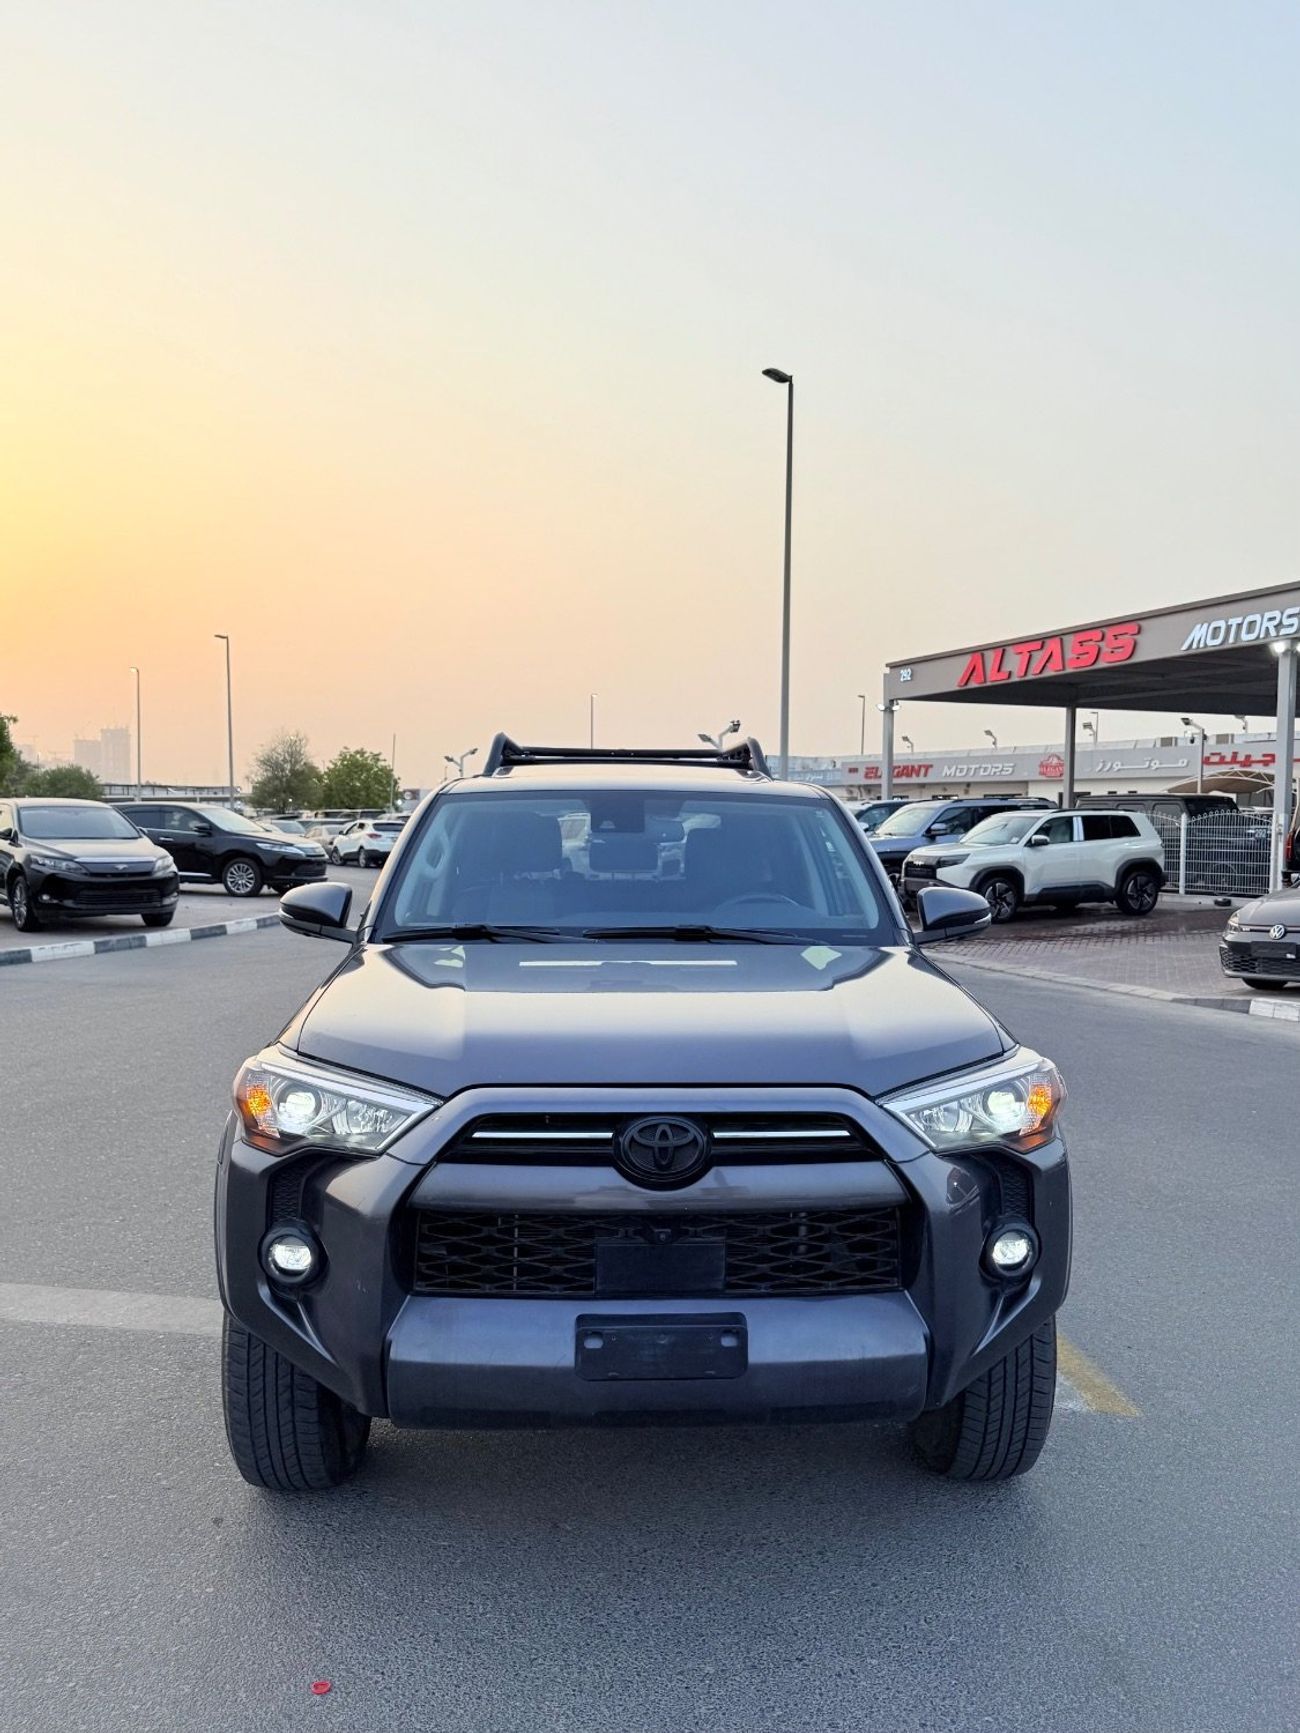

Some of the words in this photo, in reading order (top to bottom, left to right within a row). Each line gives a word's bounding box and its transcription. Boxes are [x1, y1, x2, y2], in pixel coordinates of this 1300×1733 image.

[957, 622, 1141, 687] ALTASS
[1180, 606, 1300, 651] MOTORS
[900, 667, 912, 682] 292
[863, 764, 933, 780] ELGANT
[942, 763, 1016, 778] MOTORS
